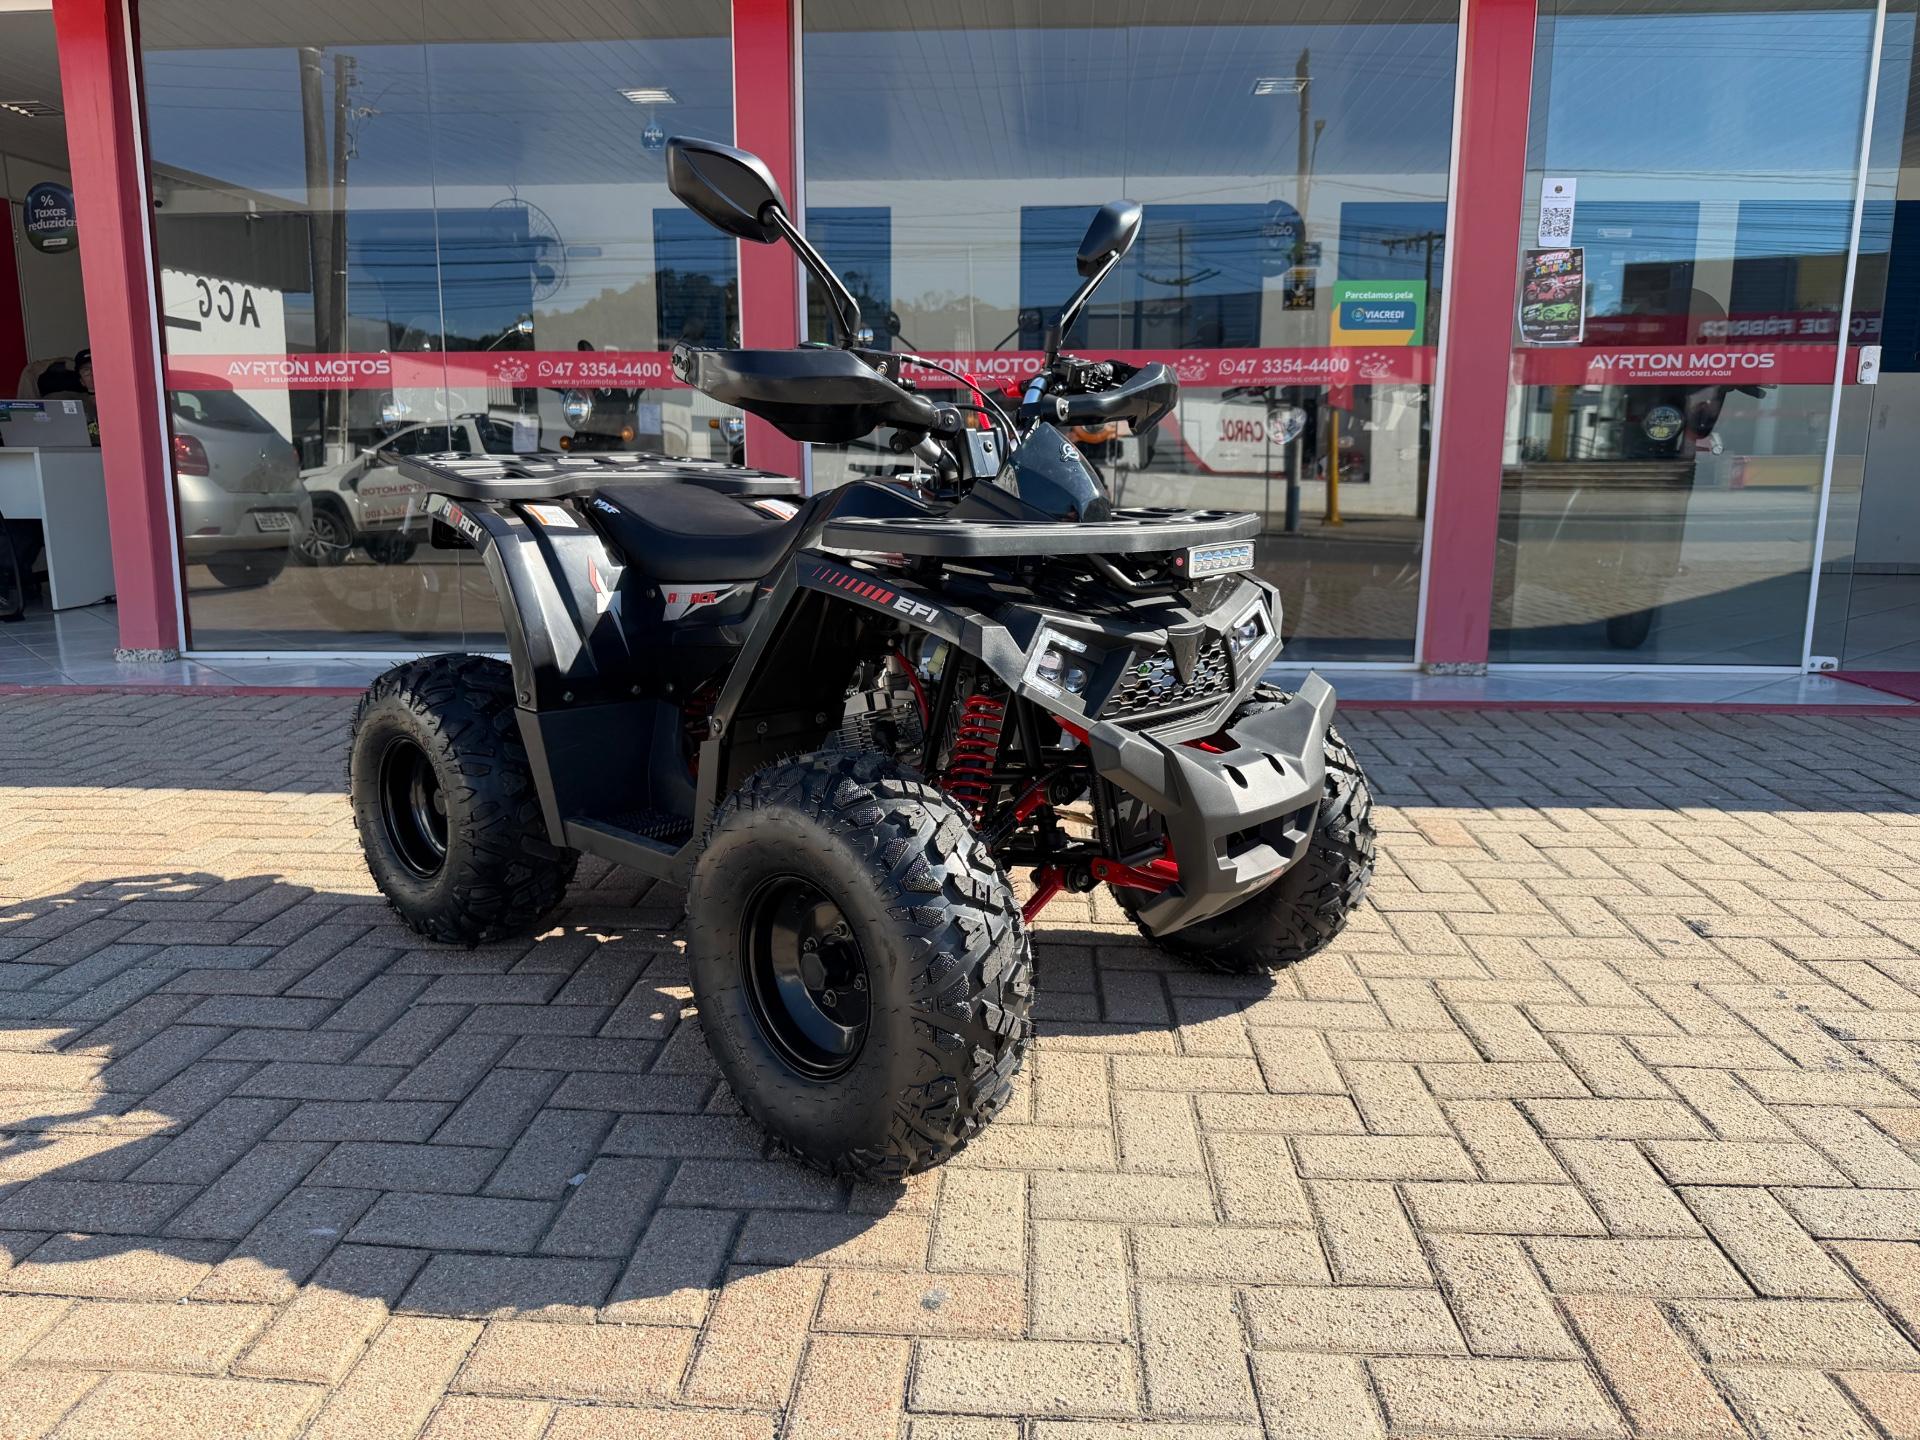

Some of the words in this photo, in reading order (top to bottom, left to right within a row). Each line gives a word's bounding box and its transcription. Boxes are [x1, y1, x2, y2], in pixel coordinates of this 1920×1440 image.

[34, 208, 67, 218] Taxas
[1345, 291, 1394, 300] Parcelamos
[1394, 291, 1414, 301] pela
[1365, 310, 1405, 319] VIACREDI
[227, 360, 310, 376] AYRTON
[315, 360, 391, 375] MOTOS
[975, 357, 1041, 374] MOTO
[1235, 358, 1257, 375] 47
[1262, 358, 1350, 375] 3354-4400
[1589, 353, 1683, 370] AYRTON
[1689, 353, 1775, 369] MOTOS
[554, 363, 574, 377] 47
[579, 362, 662, 378] 3354-4400
[1669, 369, 1704, 377] NEGÓCIO
[892, 595, 940, 624] EFI
